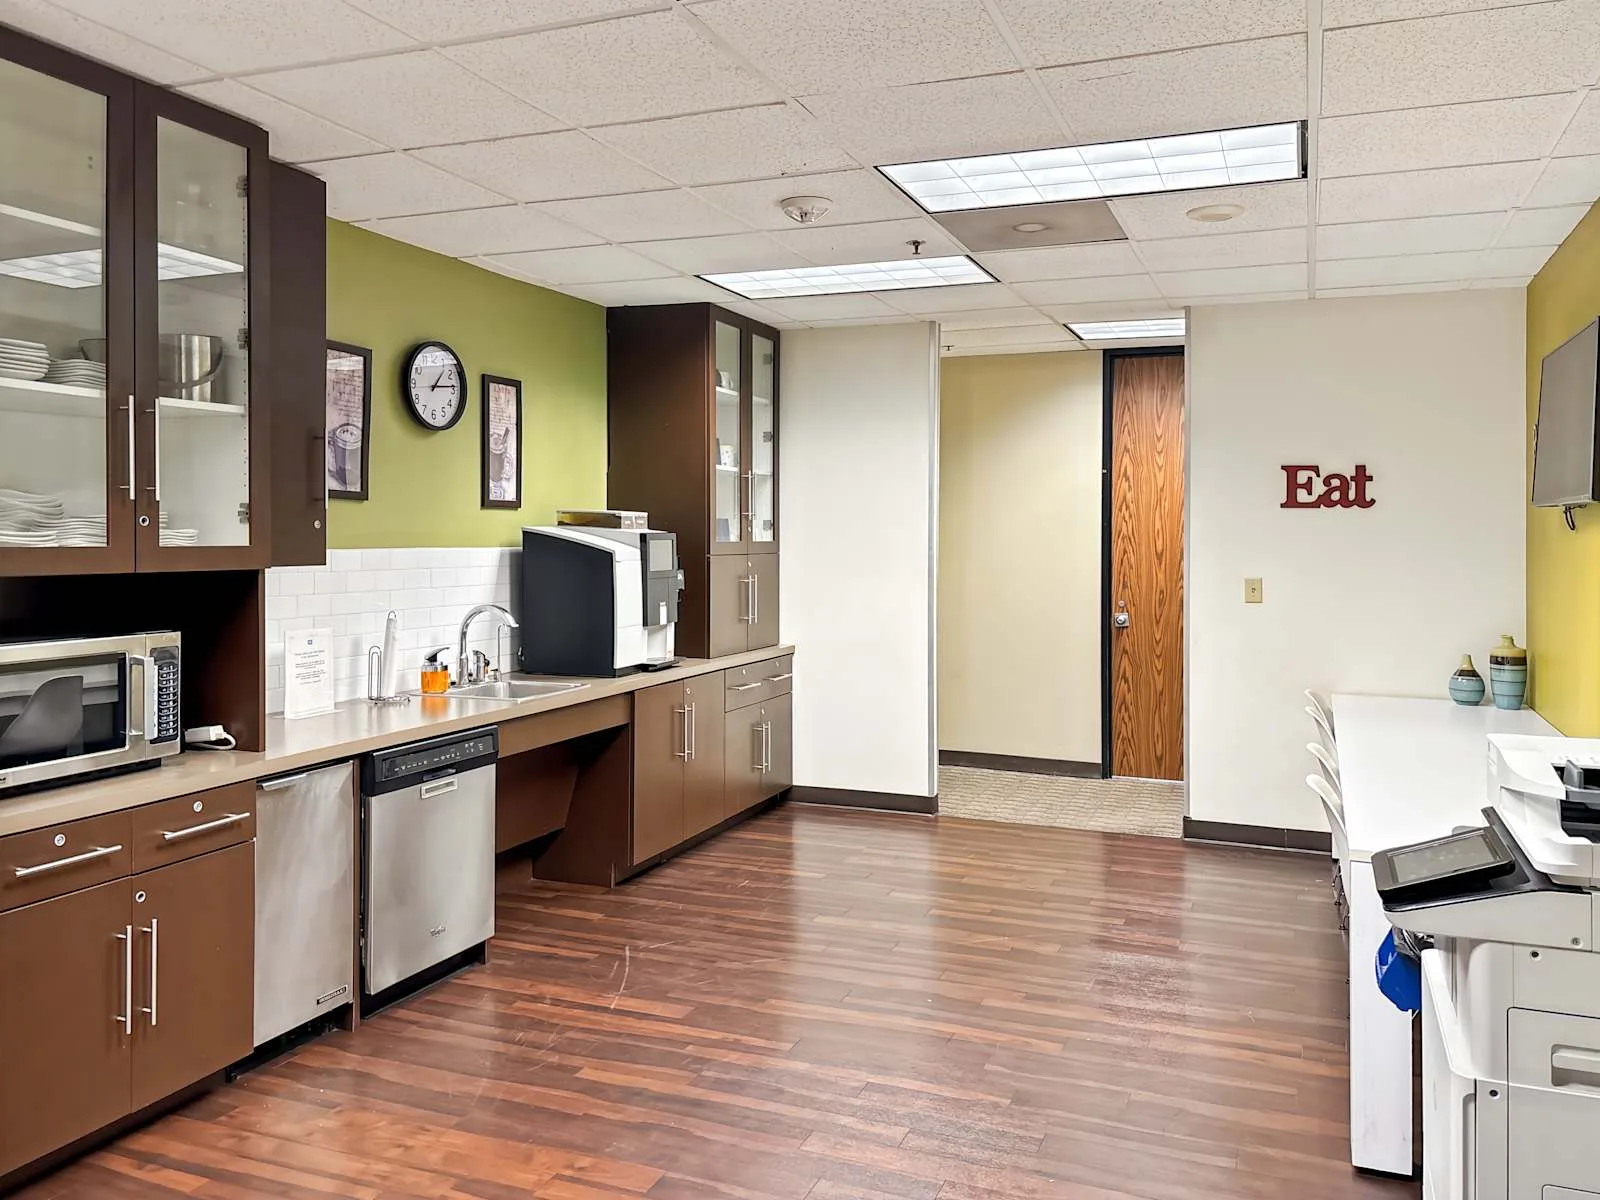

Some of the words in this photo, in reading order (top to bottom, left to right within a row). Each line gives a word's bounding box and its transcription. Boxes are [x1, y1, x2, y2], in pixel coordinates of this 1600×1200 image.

[448, 370, 453, 380] 2
[411, 378, 416, 389] 9
[450, 384, 456, 394] 3
[414, 394, 419, 404] 8
[447, 399, 452, 409] 4
[421, 404, 427, 415] 7
[431, 409, 437, 420] 6
[441, 407, 446, 418] 5
[1280, 464, 1376, 509] Eat
